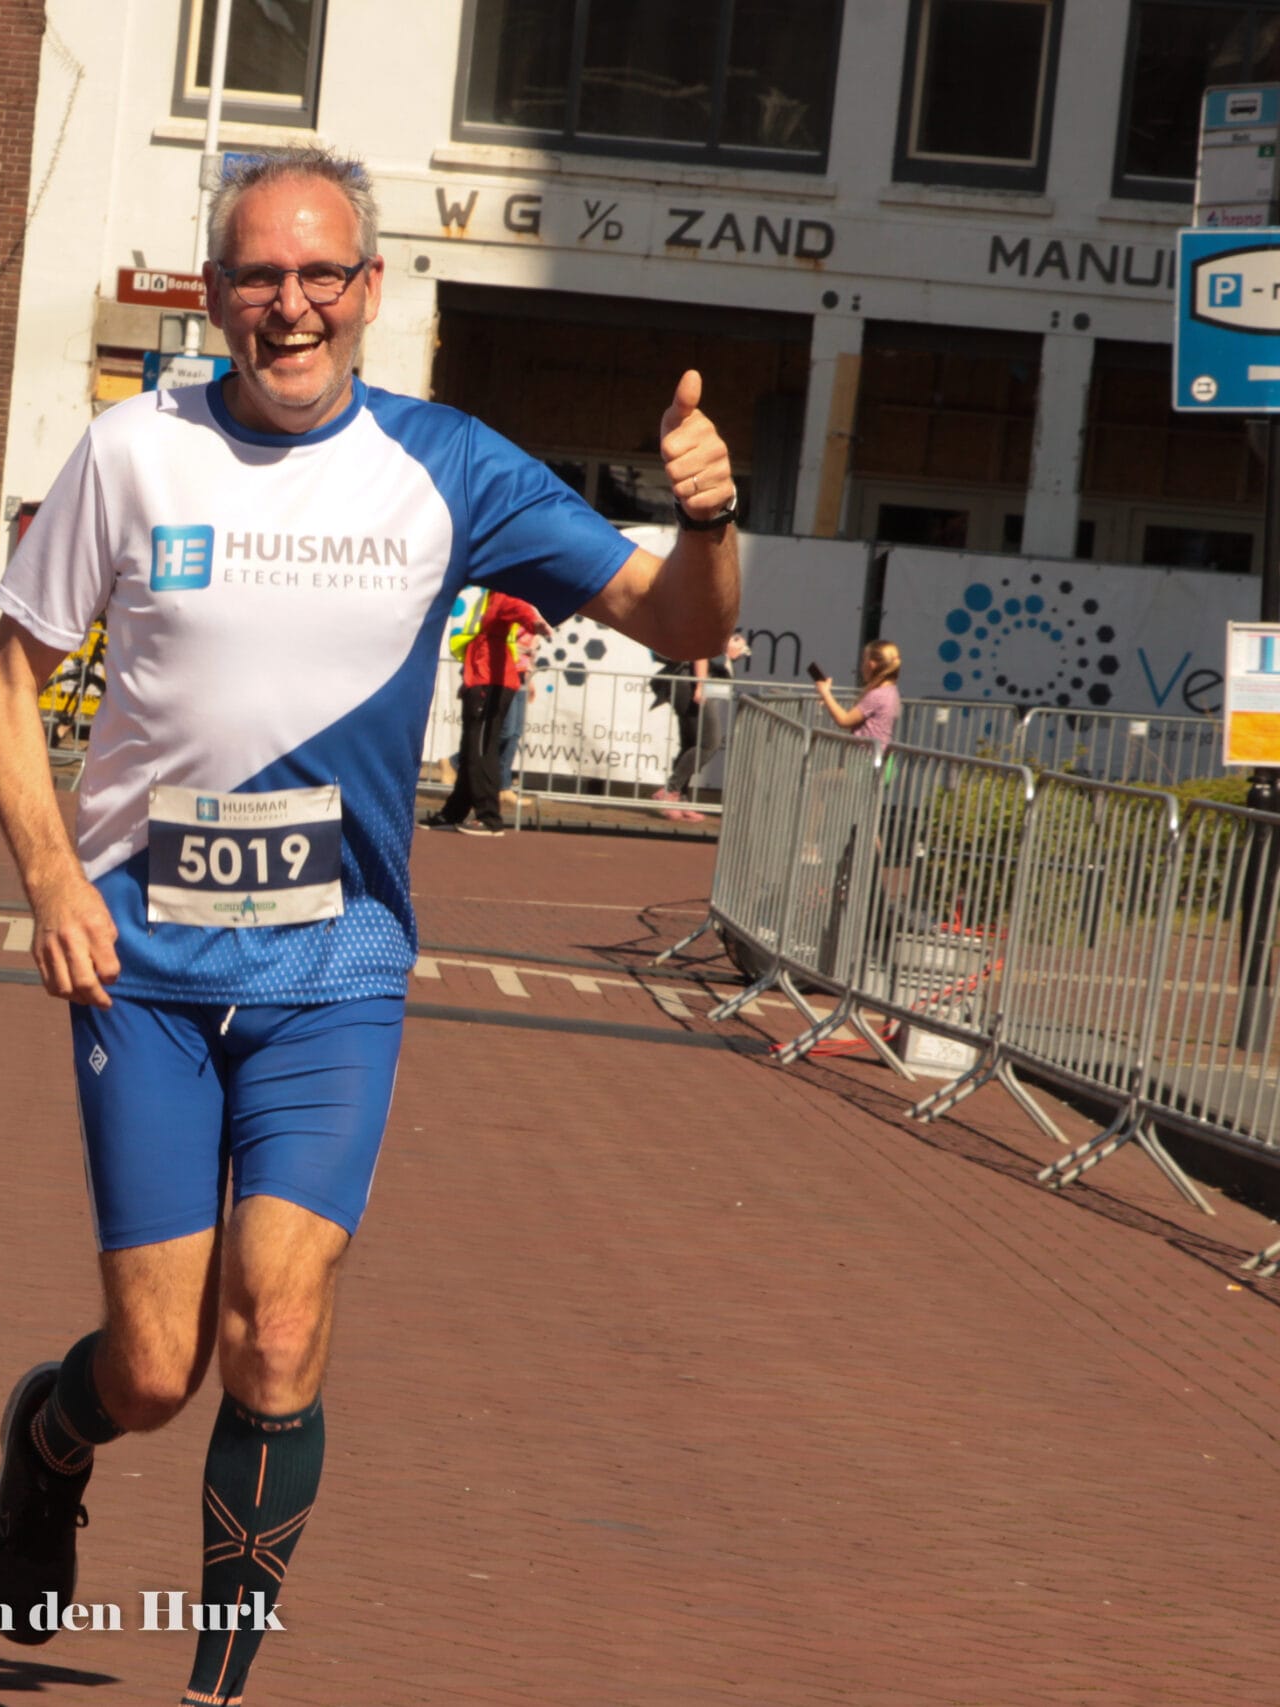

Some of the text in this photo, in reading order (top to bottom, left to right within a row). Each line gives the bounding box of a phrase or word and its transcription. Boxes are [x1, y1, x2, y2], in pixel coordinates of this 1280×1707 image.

[665, 207, 835, 260] ZAND
[168, 278, 208, 292] Bonds
[225, 532, 409, 566] HUISMAN
[223, 568, 409, 591] ETECH EXPERTS
[223, 799, 288, 814] HUISMAN
[177, 833, 311, 886] 5019
